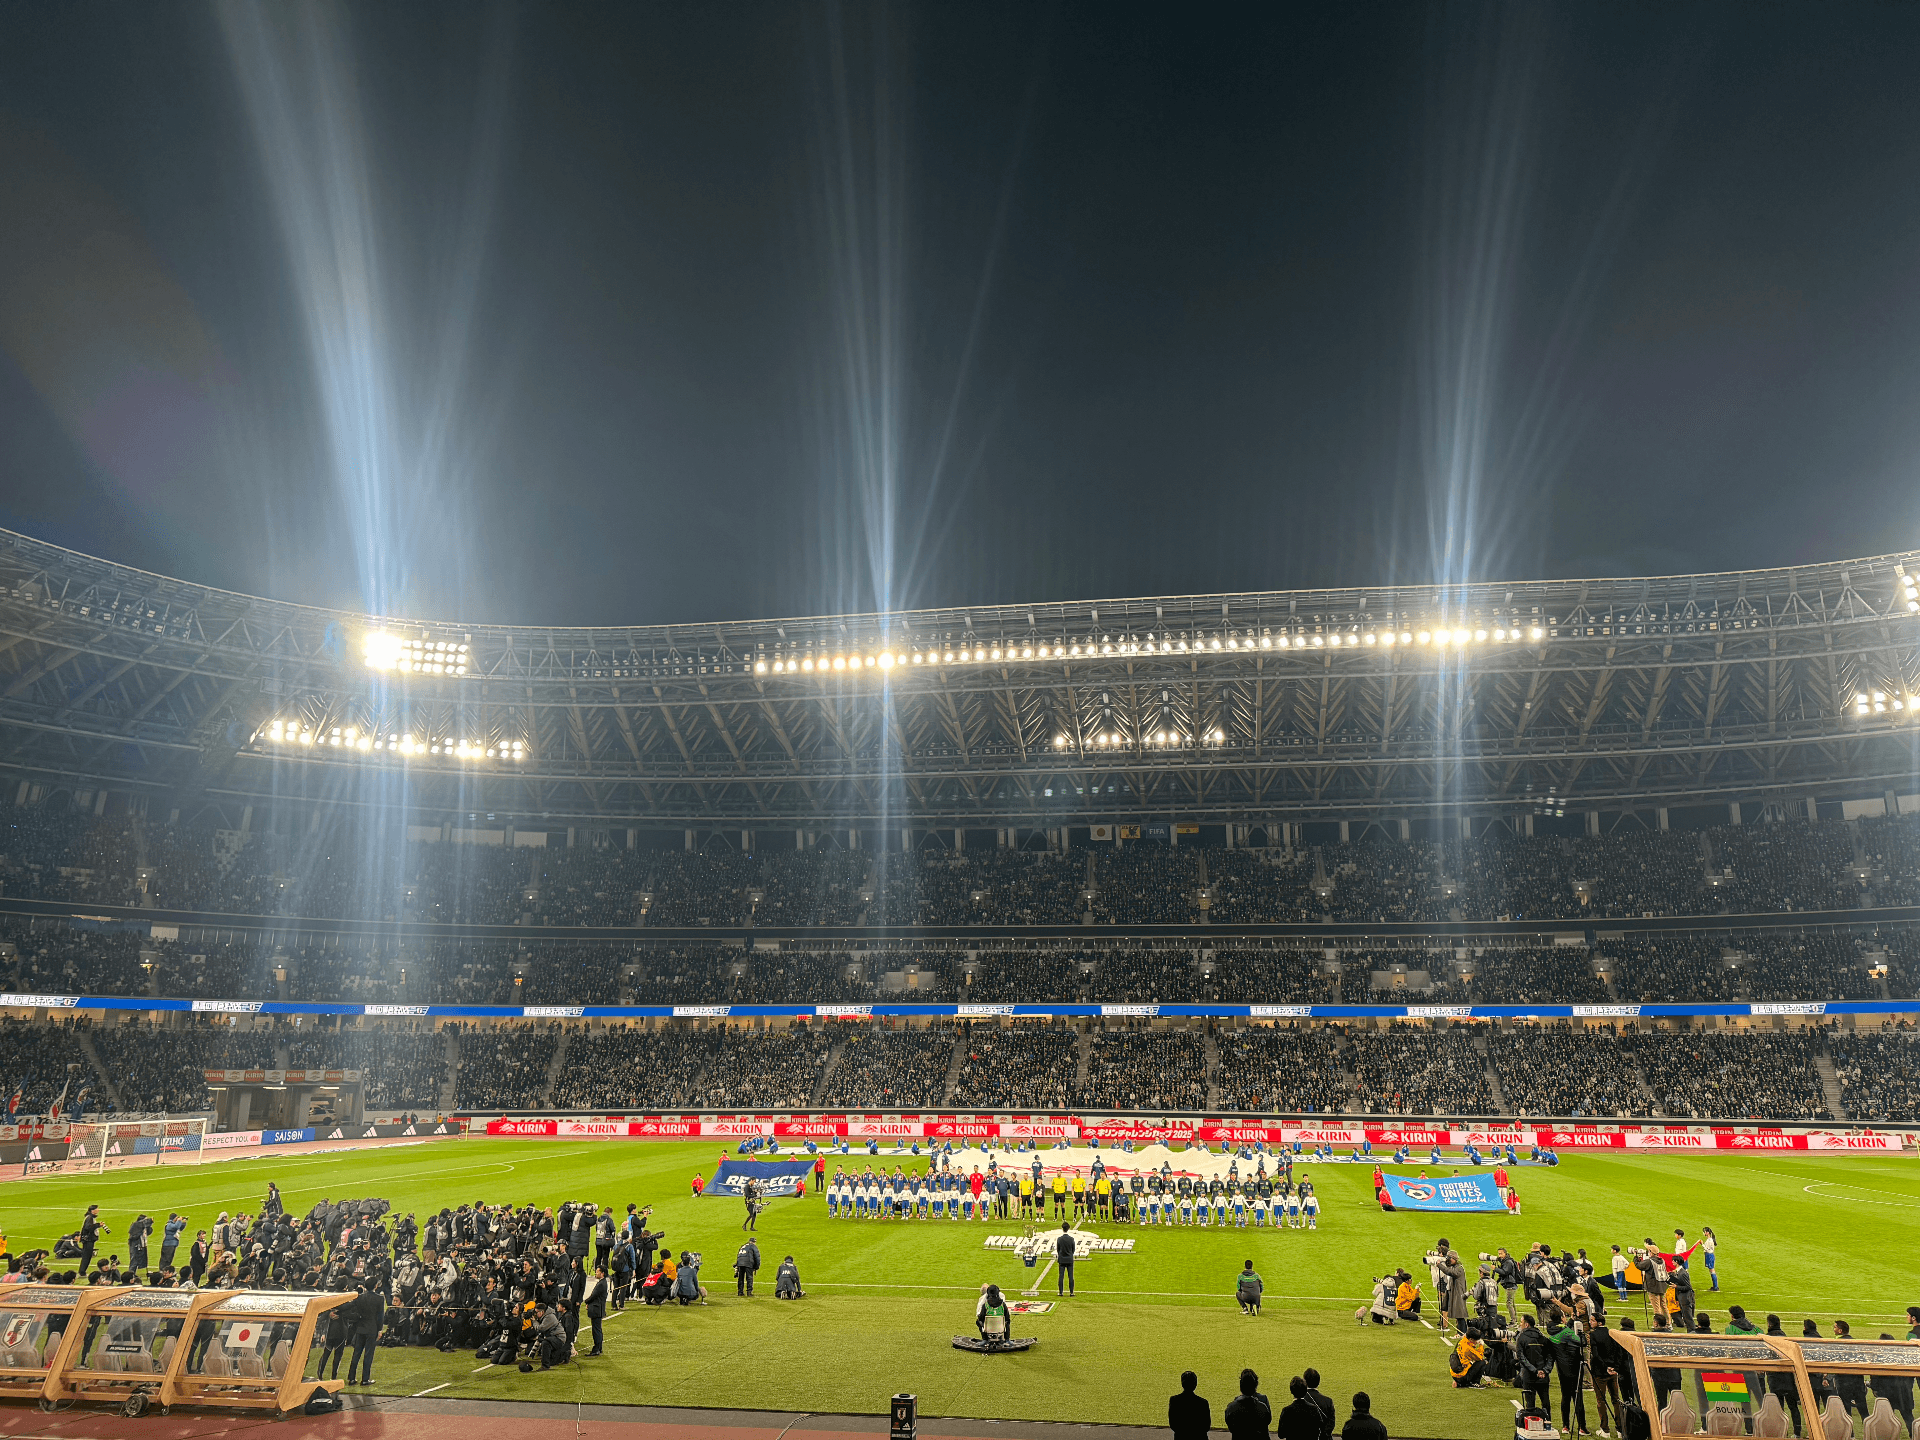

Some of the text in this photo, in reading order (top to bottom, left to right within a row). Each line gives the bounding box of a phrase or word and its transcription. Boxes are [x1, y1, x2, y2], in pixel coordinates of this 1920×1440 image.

[517, 1124, 547, 1133] KIRIN
[587, 1124, 617, 1134] KIRIN
[658, 1124, 690, 1134] KIRIN
[731, 1124, 762, 1134] KIRIN
[805, 1124, 837, 1134] KIRIN
[880, 1124, 911, 1134] KIRIN
[955, 1125, 988, 1135] KIRIN
[1032, 1126, 1065, 1136] KIRIN
[274, 1130, 303, 1142] SAISON
[1172, 1129, 1193, 1139] 2025
[1233, 1129, 1269, 1140] KIRIN
[1316, 1131, 1352, 1141] KIRIN
[1401, 1132, 1437, 1143] KIRIN
[1487, 1133, 1523, 1143] KIRIN
[203, 1136, 234, 1145] RESPECT
[1574, 1134, 1612, 1145] KIRIN
[1663, 1135, 1701, 1146] KIRIN
[1754, 1136, 1794, 1147] KIRIN
[1847, 1137, 1887, 1148] KIRIN
[725, 1175, 800, 1188] REECT
[1438, 1181, 1479, 1190] FOOTBALL
[1440, 1188, 1483, 1198] UNITES
[1716, 1406, 1747, 1414] BOLIVIA
